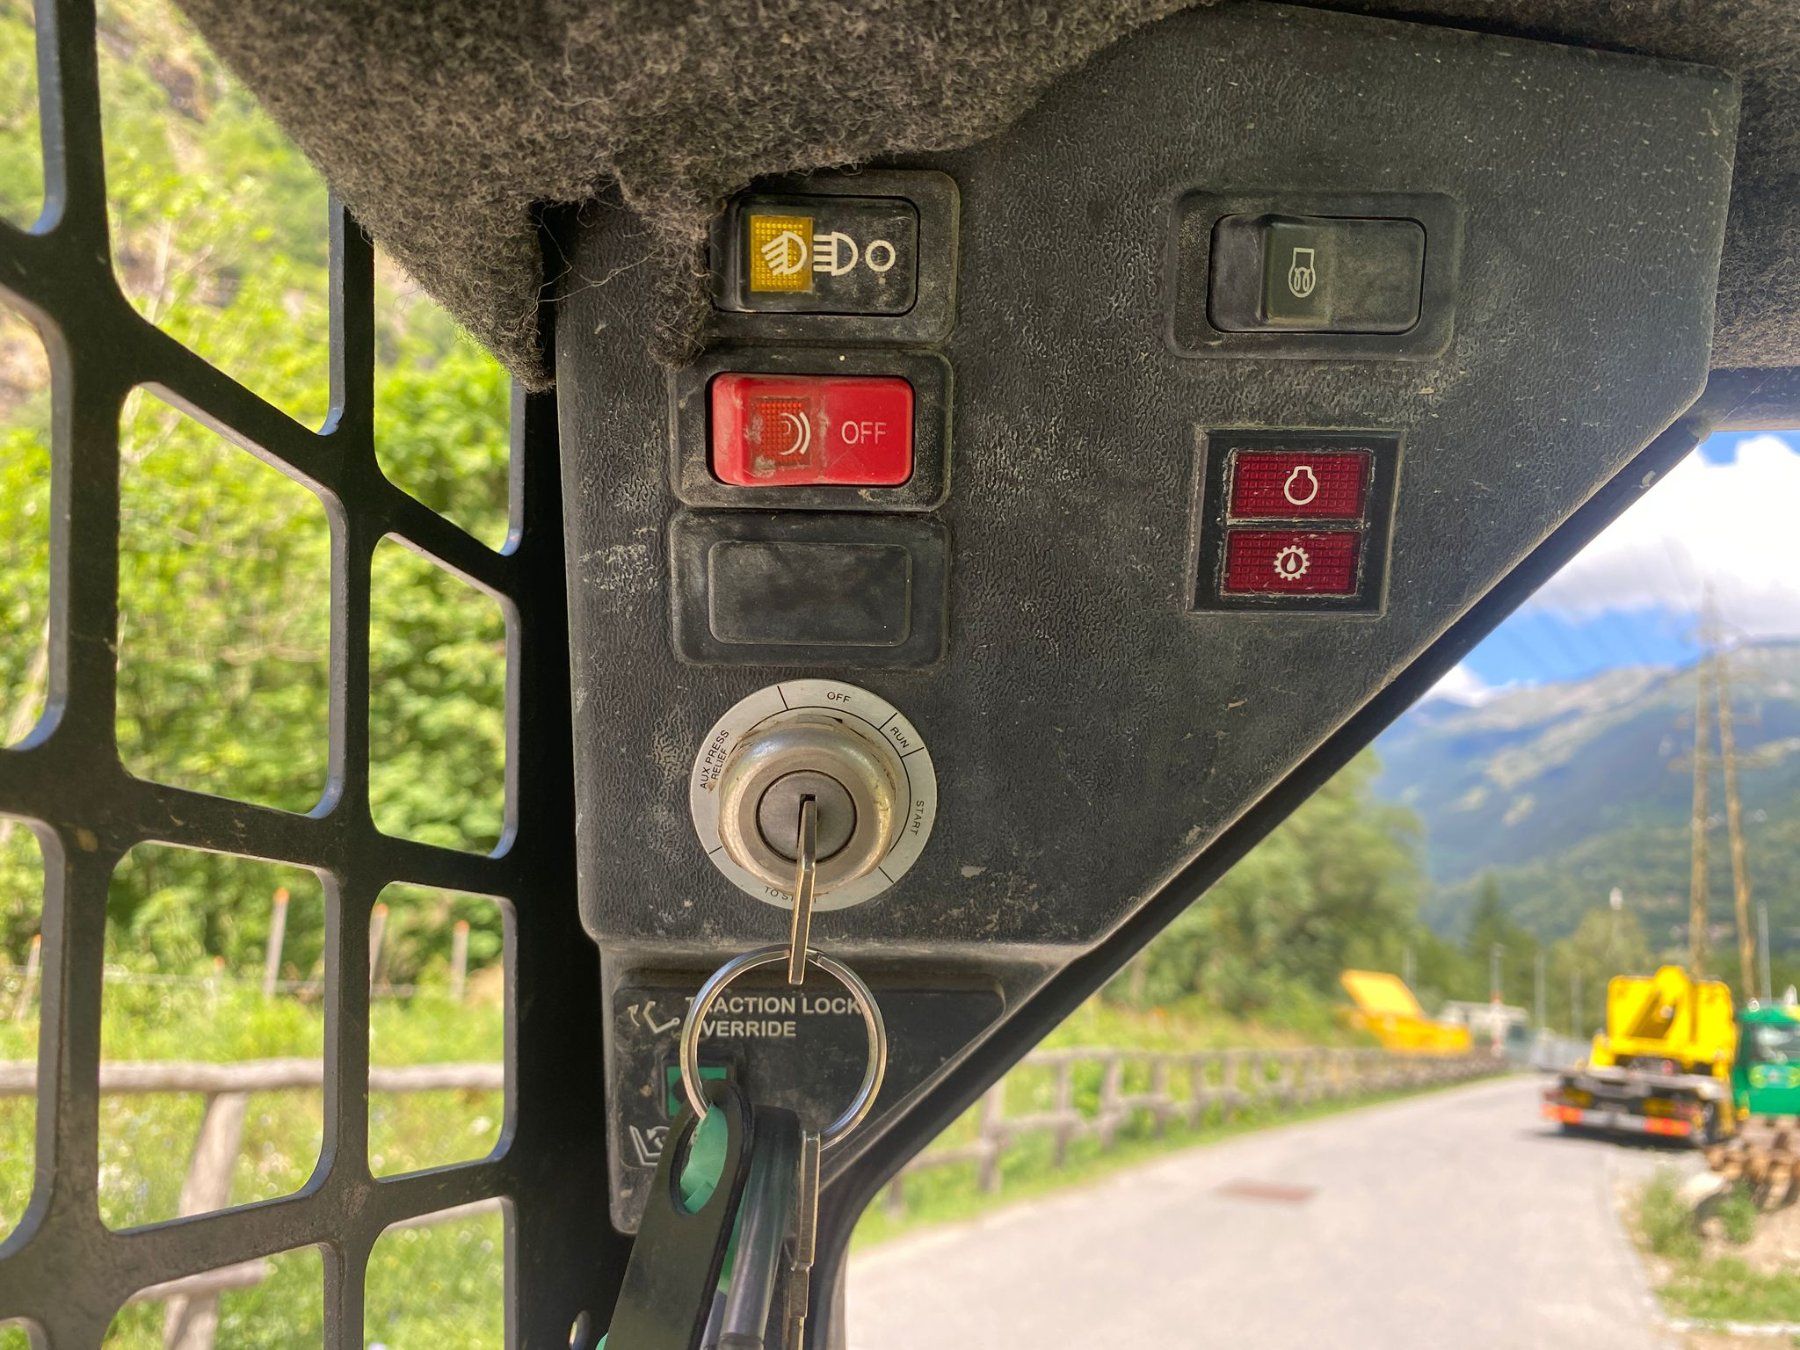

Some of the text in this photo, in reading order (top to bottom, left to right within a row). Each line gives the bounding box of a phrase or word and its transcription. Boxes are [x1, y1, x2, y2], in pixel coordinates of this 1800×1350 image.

[841, 420, 887, 444] OFF
[826, 691, 851, 704] OFF
[889, 726, 909, 748] RUN
[699, 729, 730, 790] AUX PRESS
[710, 747, 728, 780] RELIEF
[911, 799, 925, 836] START
[684, 996, 862, 1014] TACTION LOCK
[701, 1020, 797, 1037] VERRIDE
